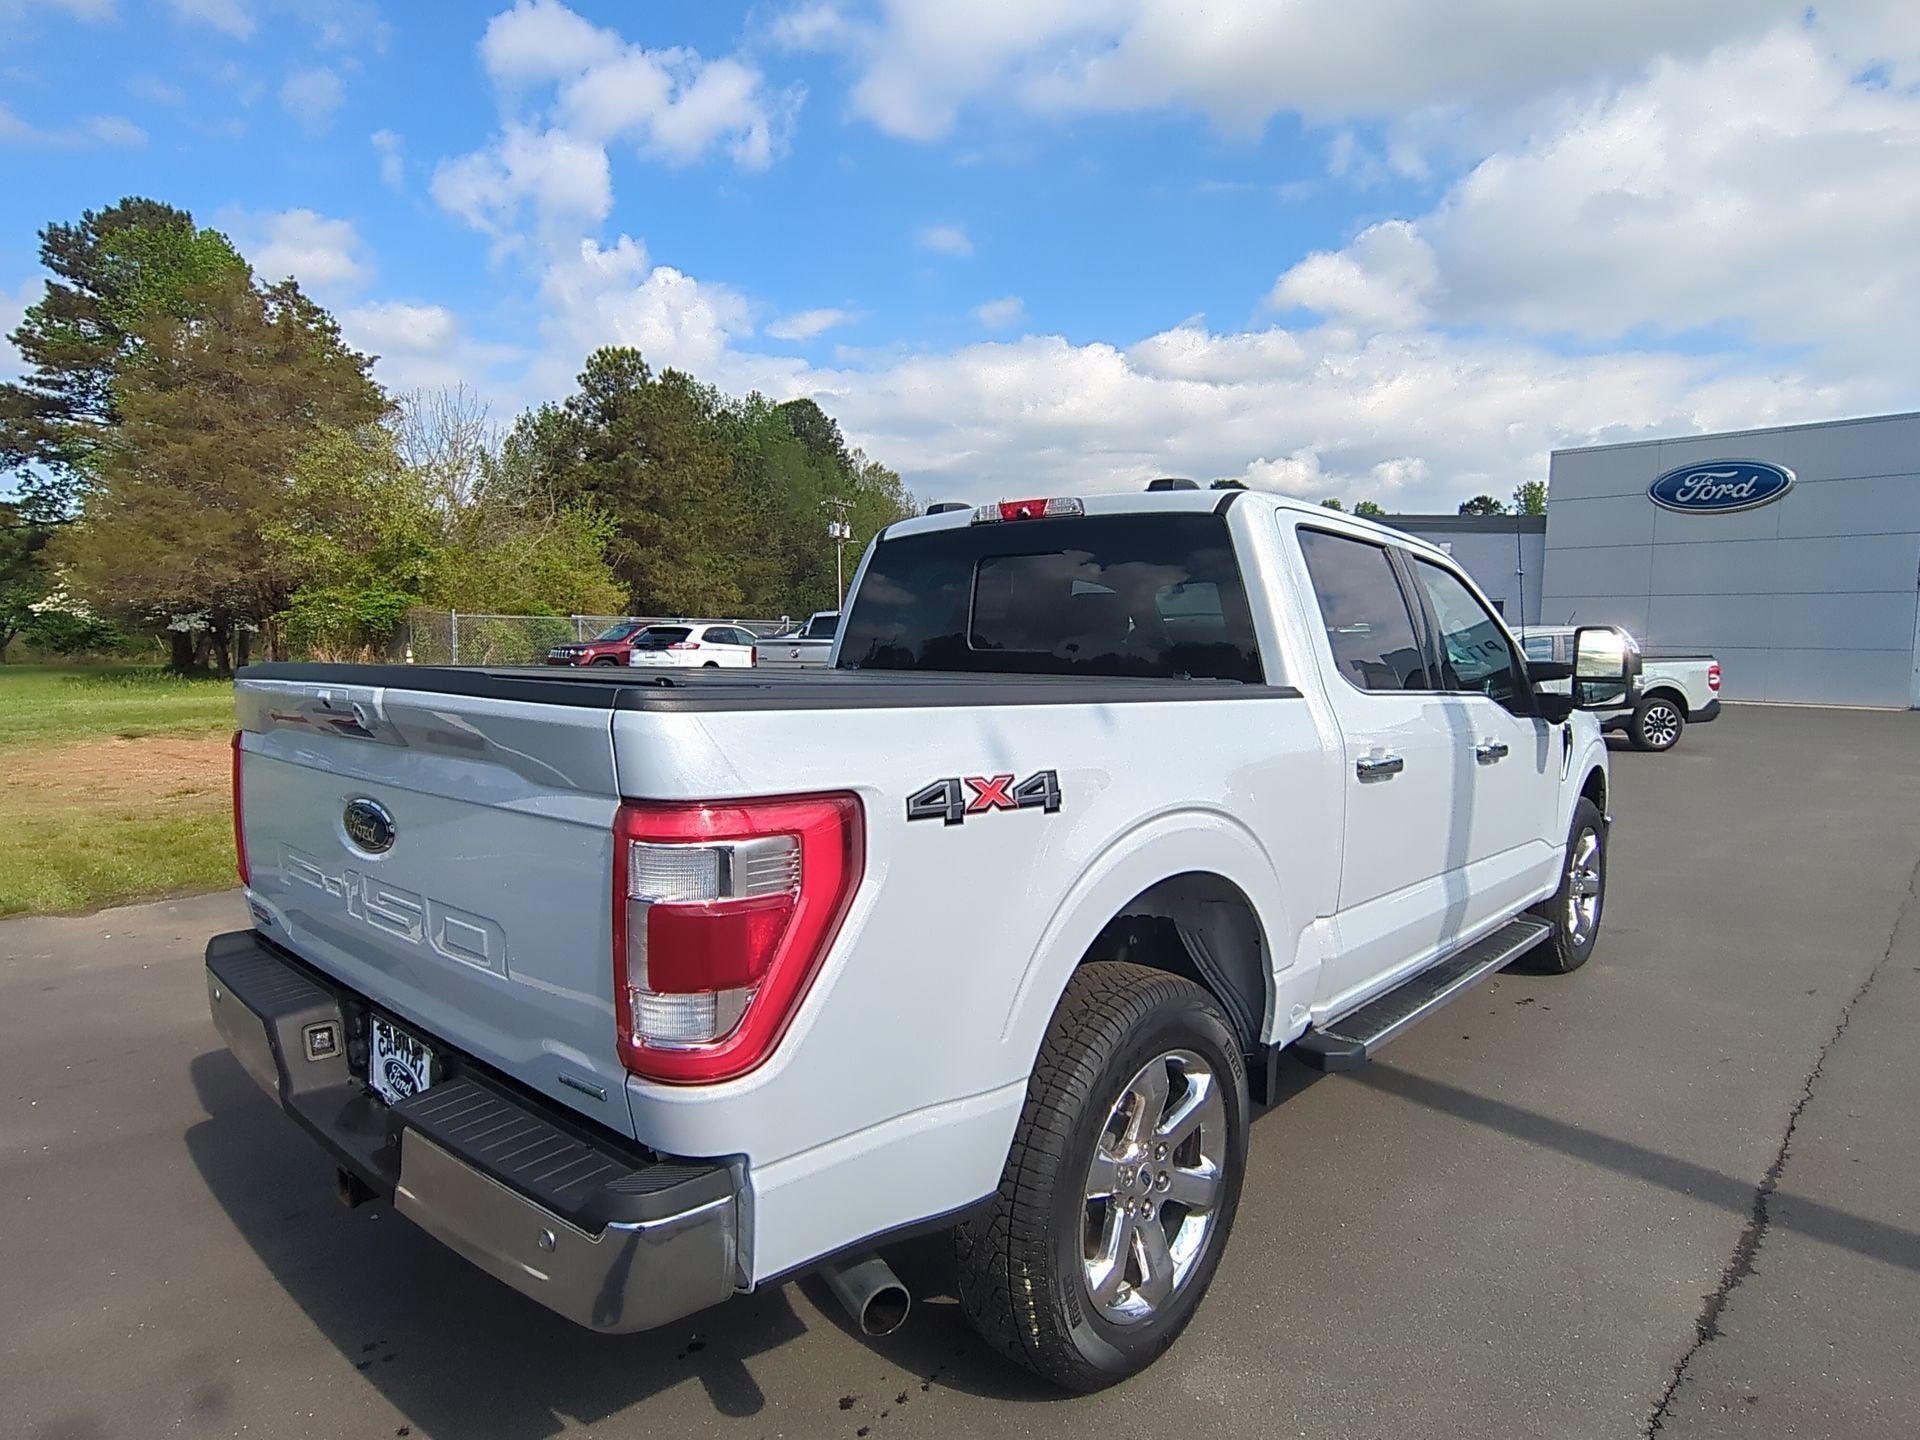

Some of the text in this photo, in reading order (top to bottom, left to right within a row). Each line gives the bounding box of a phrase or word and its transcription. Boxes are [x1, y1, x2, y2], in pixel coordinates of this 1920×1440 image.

[1675, 471, 1758, 501] Ford
[349, 809, 379, 844] Ford
[278, 841, 510, 980] F-150
[389, 1063, 413, 1097] Ford
